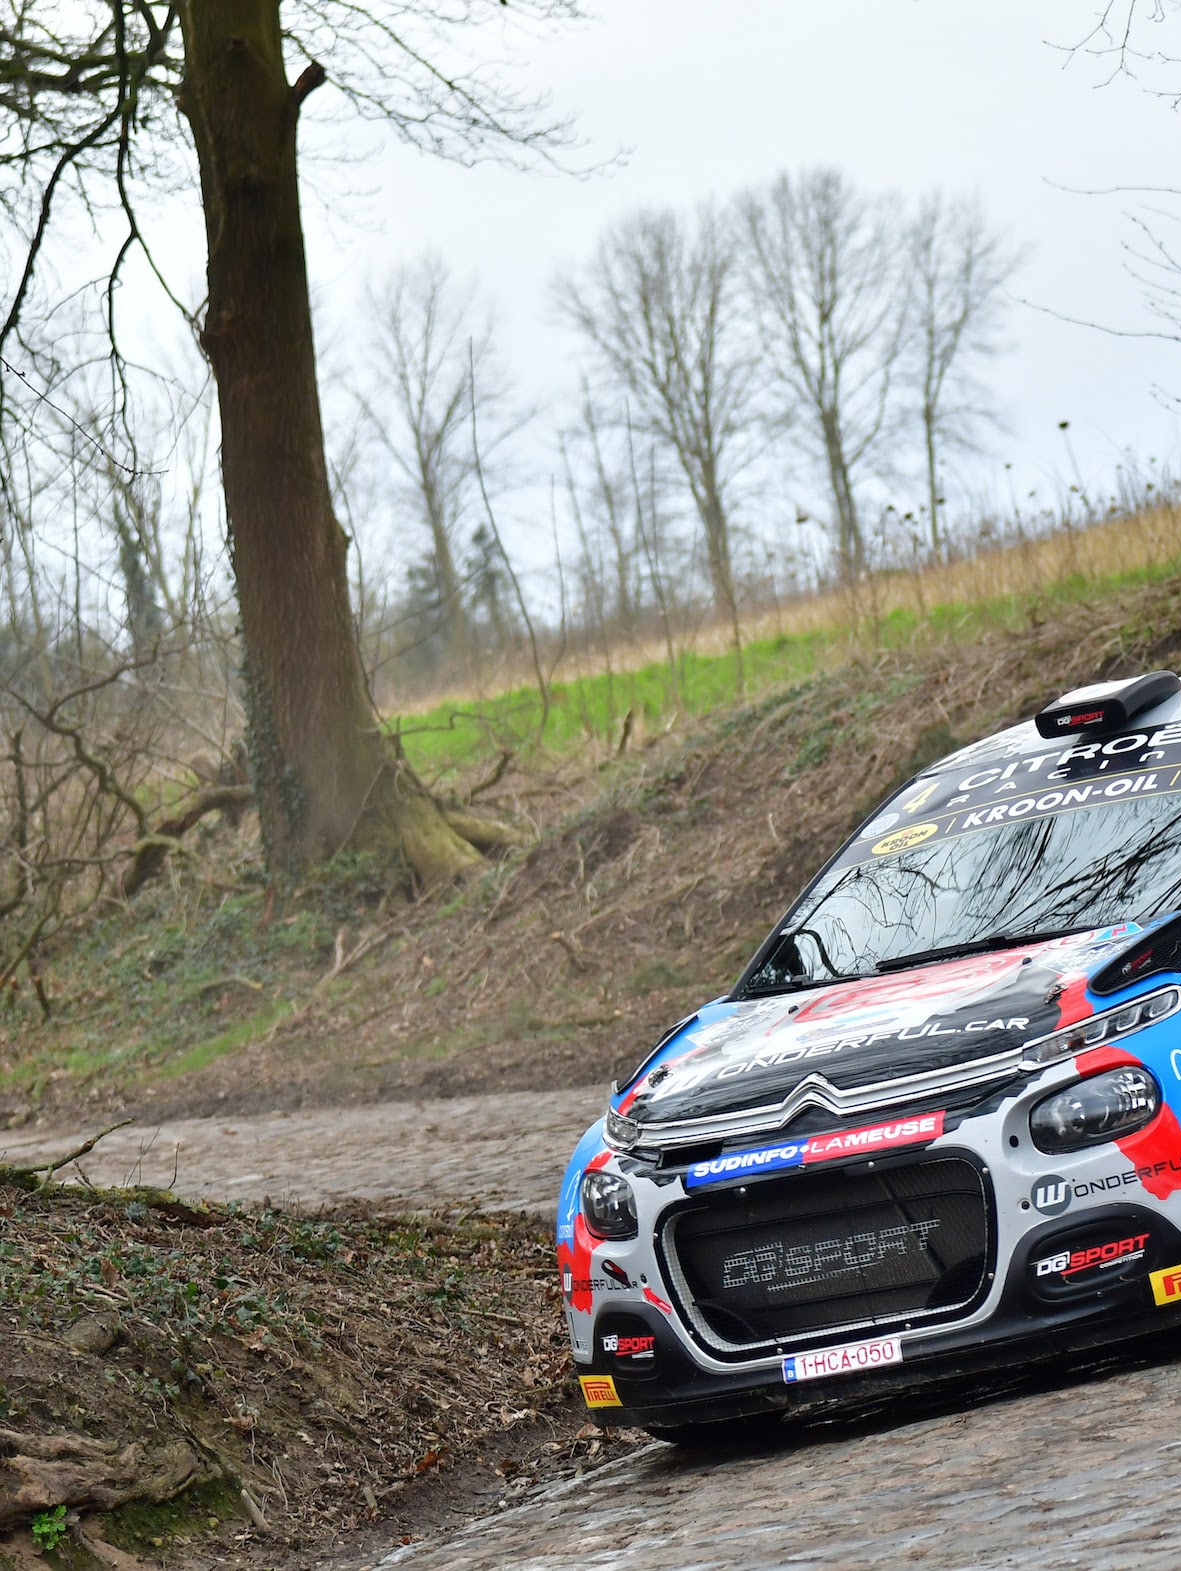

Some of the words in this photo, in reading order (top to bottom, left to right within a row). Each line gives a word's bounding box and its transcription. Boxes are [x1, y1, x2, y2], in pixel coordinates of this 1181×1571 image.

[901, 782, 940, 814] 4
[961, 773, 1158, 829] KROON-OIL
[881, 829, 928, 848] KROON
[889, 841, 909, 851] OIL
[800, 1341, 894, 1377] 1-HCA-050
[584, 1381, 616, 1401] PIRELLI
